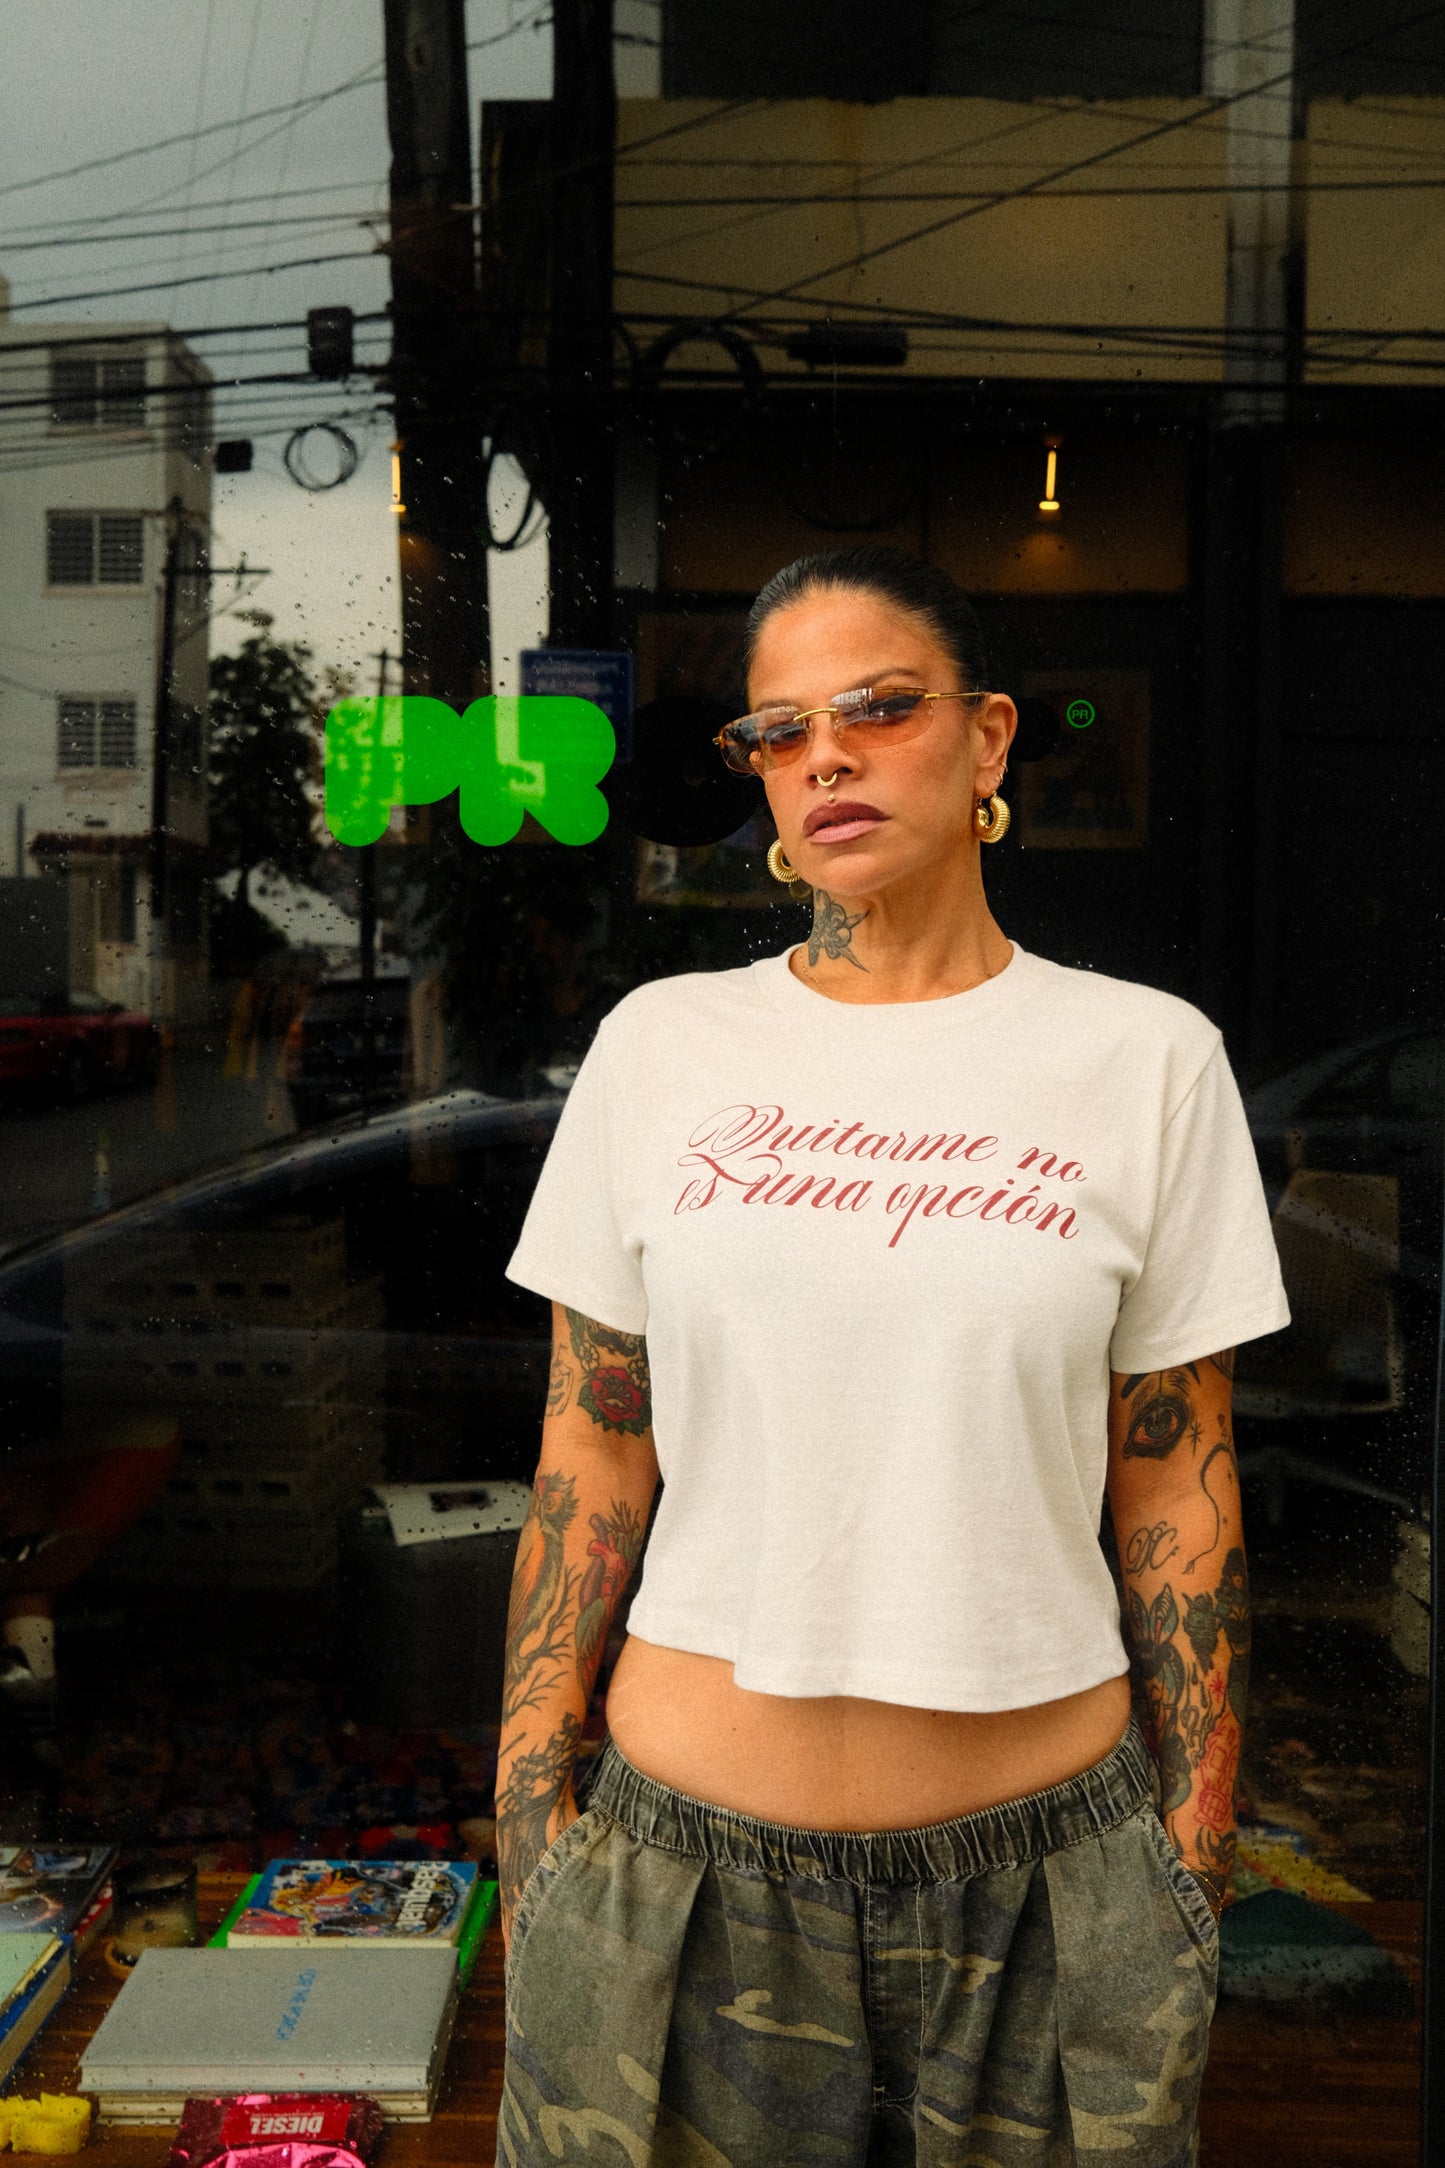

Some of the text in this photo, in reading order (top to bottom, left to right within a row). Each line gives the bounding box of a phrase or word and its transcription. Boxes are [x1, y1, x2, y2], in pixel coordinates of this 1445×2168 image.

[677, 1104, 1088, 1184] Quitarme no
[674, 1168, 1080, 1248] es una opción
[250, 2115, 324, 2134] DIESEL
